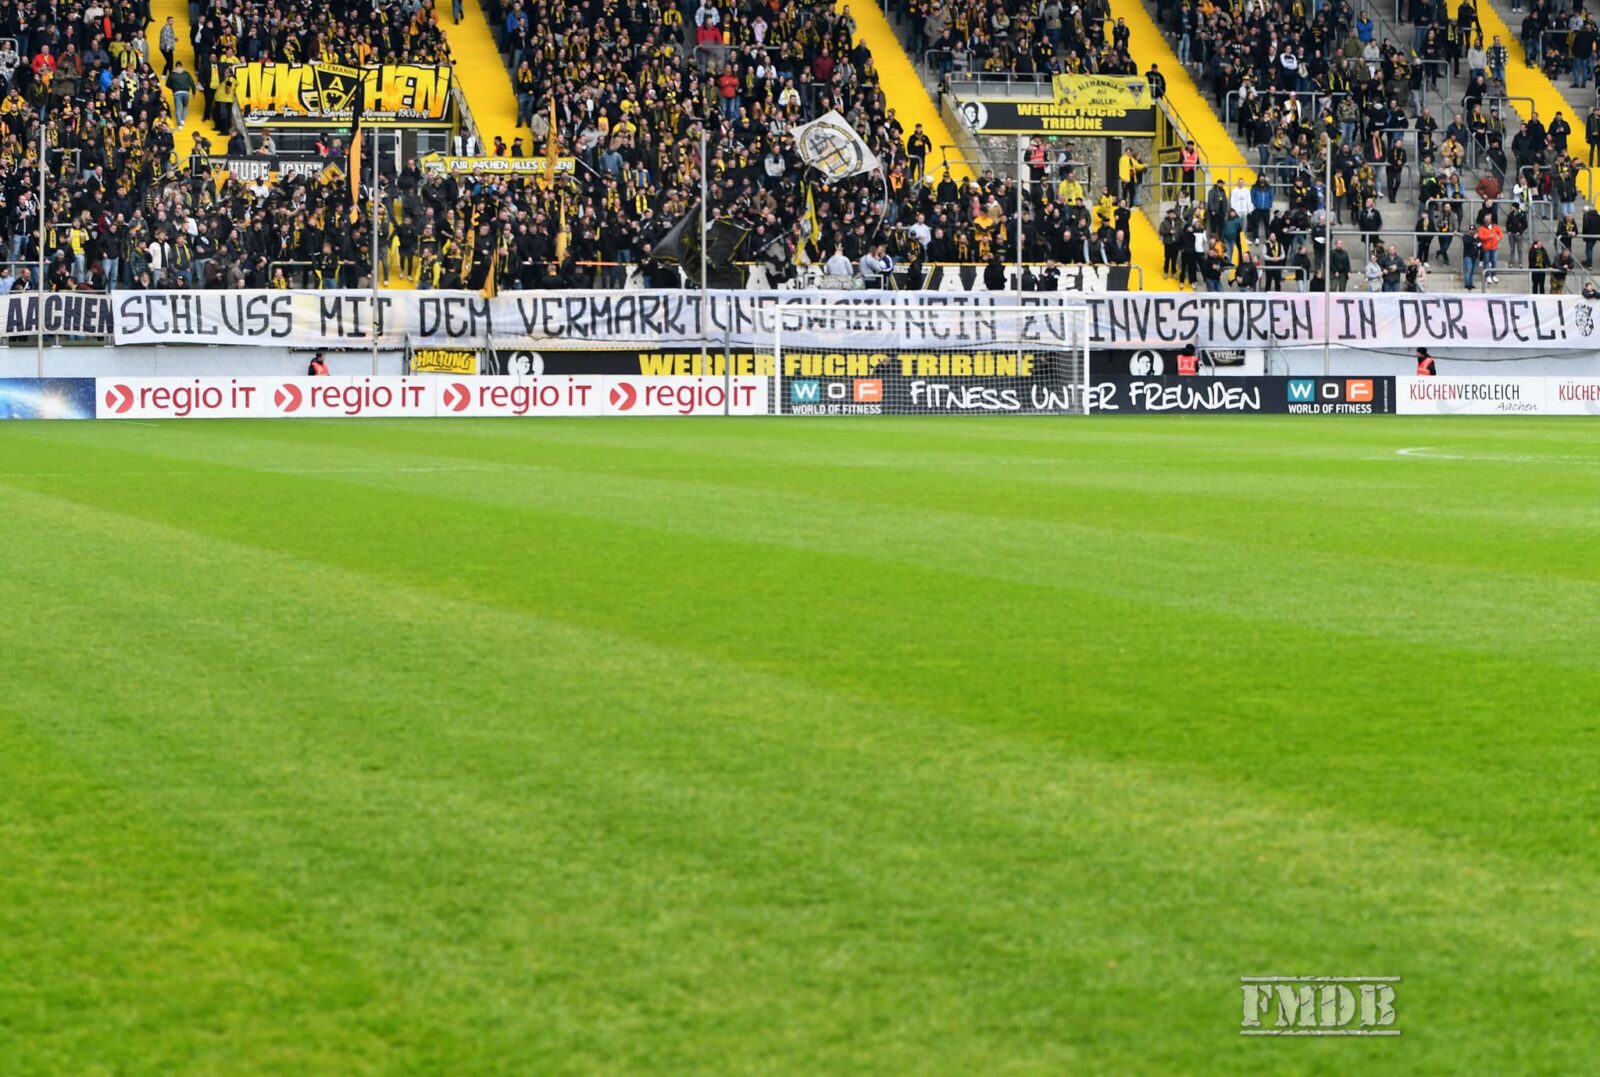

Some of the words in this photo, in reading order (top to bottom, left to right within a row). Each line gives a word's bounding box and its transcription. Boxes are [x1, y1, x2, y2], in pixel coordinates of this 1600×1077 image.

[317, 63, 357, 76] ALEMANNI
[1017, 104, 1077, 116] WERNER
[1041, 116, 1103, 130] TRIBÜNE
[511, 160, 538, 170] ALLES
[6, 294, 115, 334] AACHEN
[121, 294, 293, 338] SCHLUSS
[320, 295, 392, 338] MIT
[419, 297, 493, 338] DEM
[1021, 297, 1066, 341] ZU
[1086, 298, 1313, 342] INVESTOREN
[1336, 299, 1377, 340] IN
[1399, 299, 1468, 340] DER
[416, 350, 471, 370] HALTUNG
[639, 354, 775, 376] WERNER
[896, 350, 1035, 376] TRIBÜNE
[140, 379, 223, 416] regio
[311, 378, 393, 415] regio
[479, 378, 560, 414] regio
[645, 378, 726, 414] regio
[910, 380, 1021, 410] FITNESS
[1128, 381, 1261, 410] FREUNDEN
[1410, 379, 1520, 401] KÜCHENVERGLEICH
[792, 403, 826, 415] WORLD
[827, 403, 841, 415] OF
[842, 403, 882, 415] FITNESS
[1288, 403, 1320, 414] WORLD
[1322, 403, 1334, 414] OF
[1335, 403, 1373, 414] FITNESS
[1493, 400, 1538, 411] Aachen
